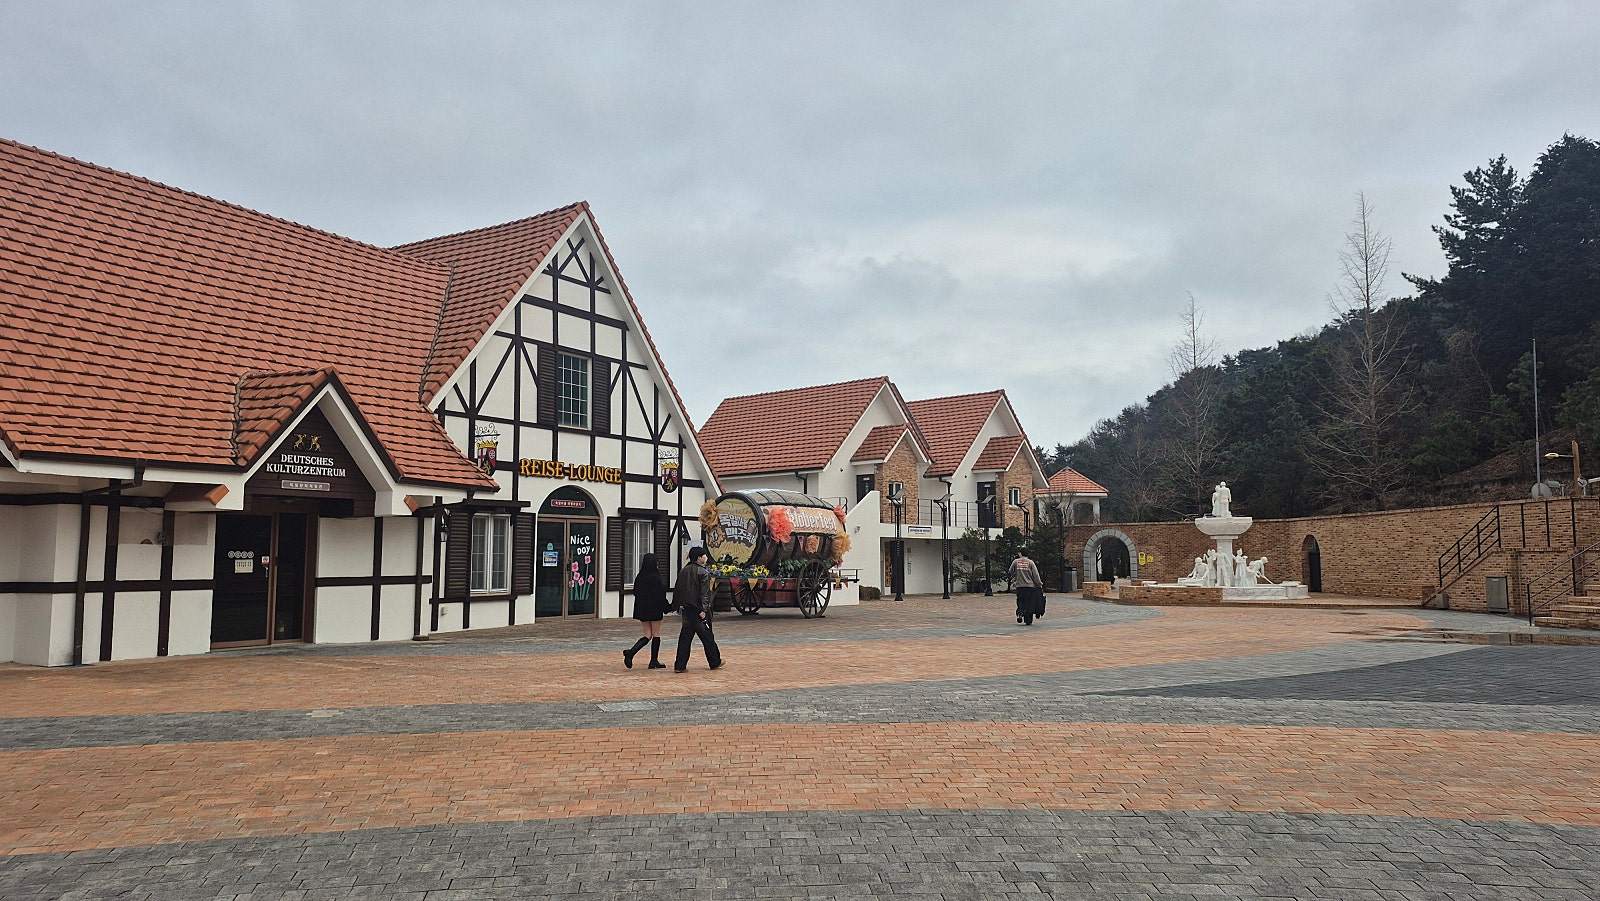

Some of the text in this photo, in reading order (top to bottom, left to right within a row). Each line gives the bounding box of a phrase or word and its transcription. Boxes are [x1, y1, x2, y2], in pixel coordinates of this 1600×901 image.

[281, 453, 334, 467] DEUTSCHES
[266, 463, 346, 477] KULTURZENTRUM
[520, 458, 622, 483] REISE-LOUNGE
[786, 508, 837, 531] ktoberfest
[570, 534, 591, 545] Nice
